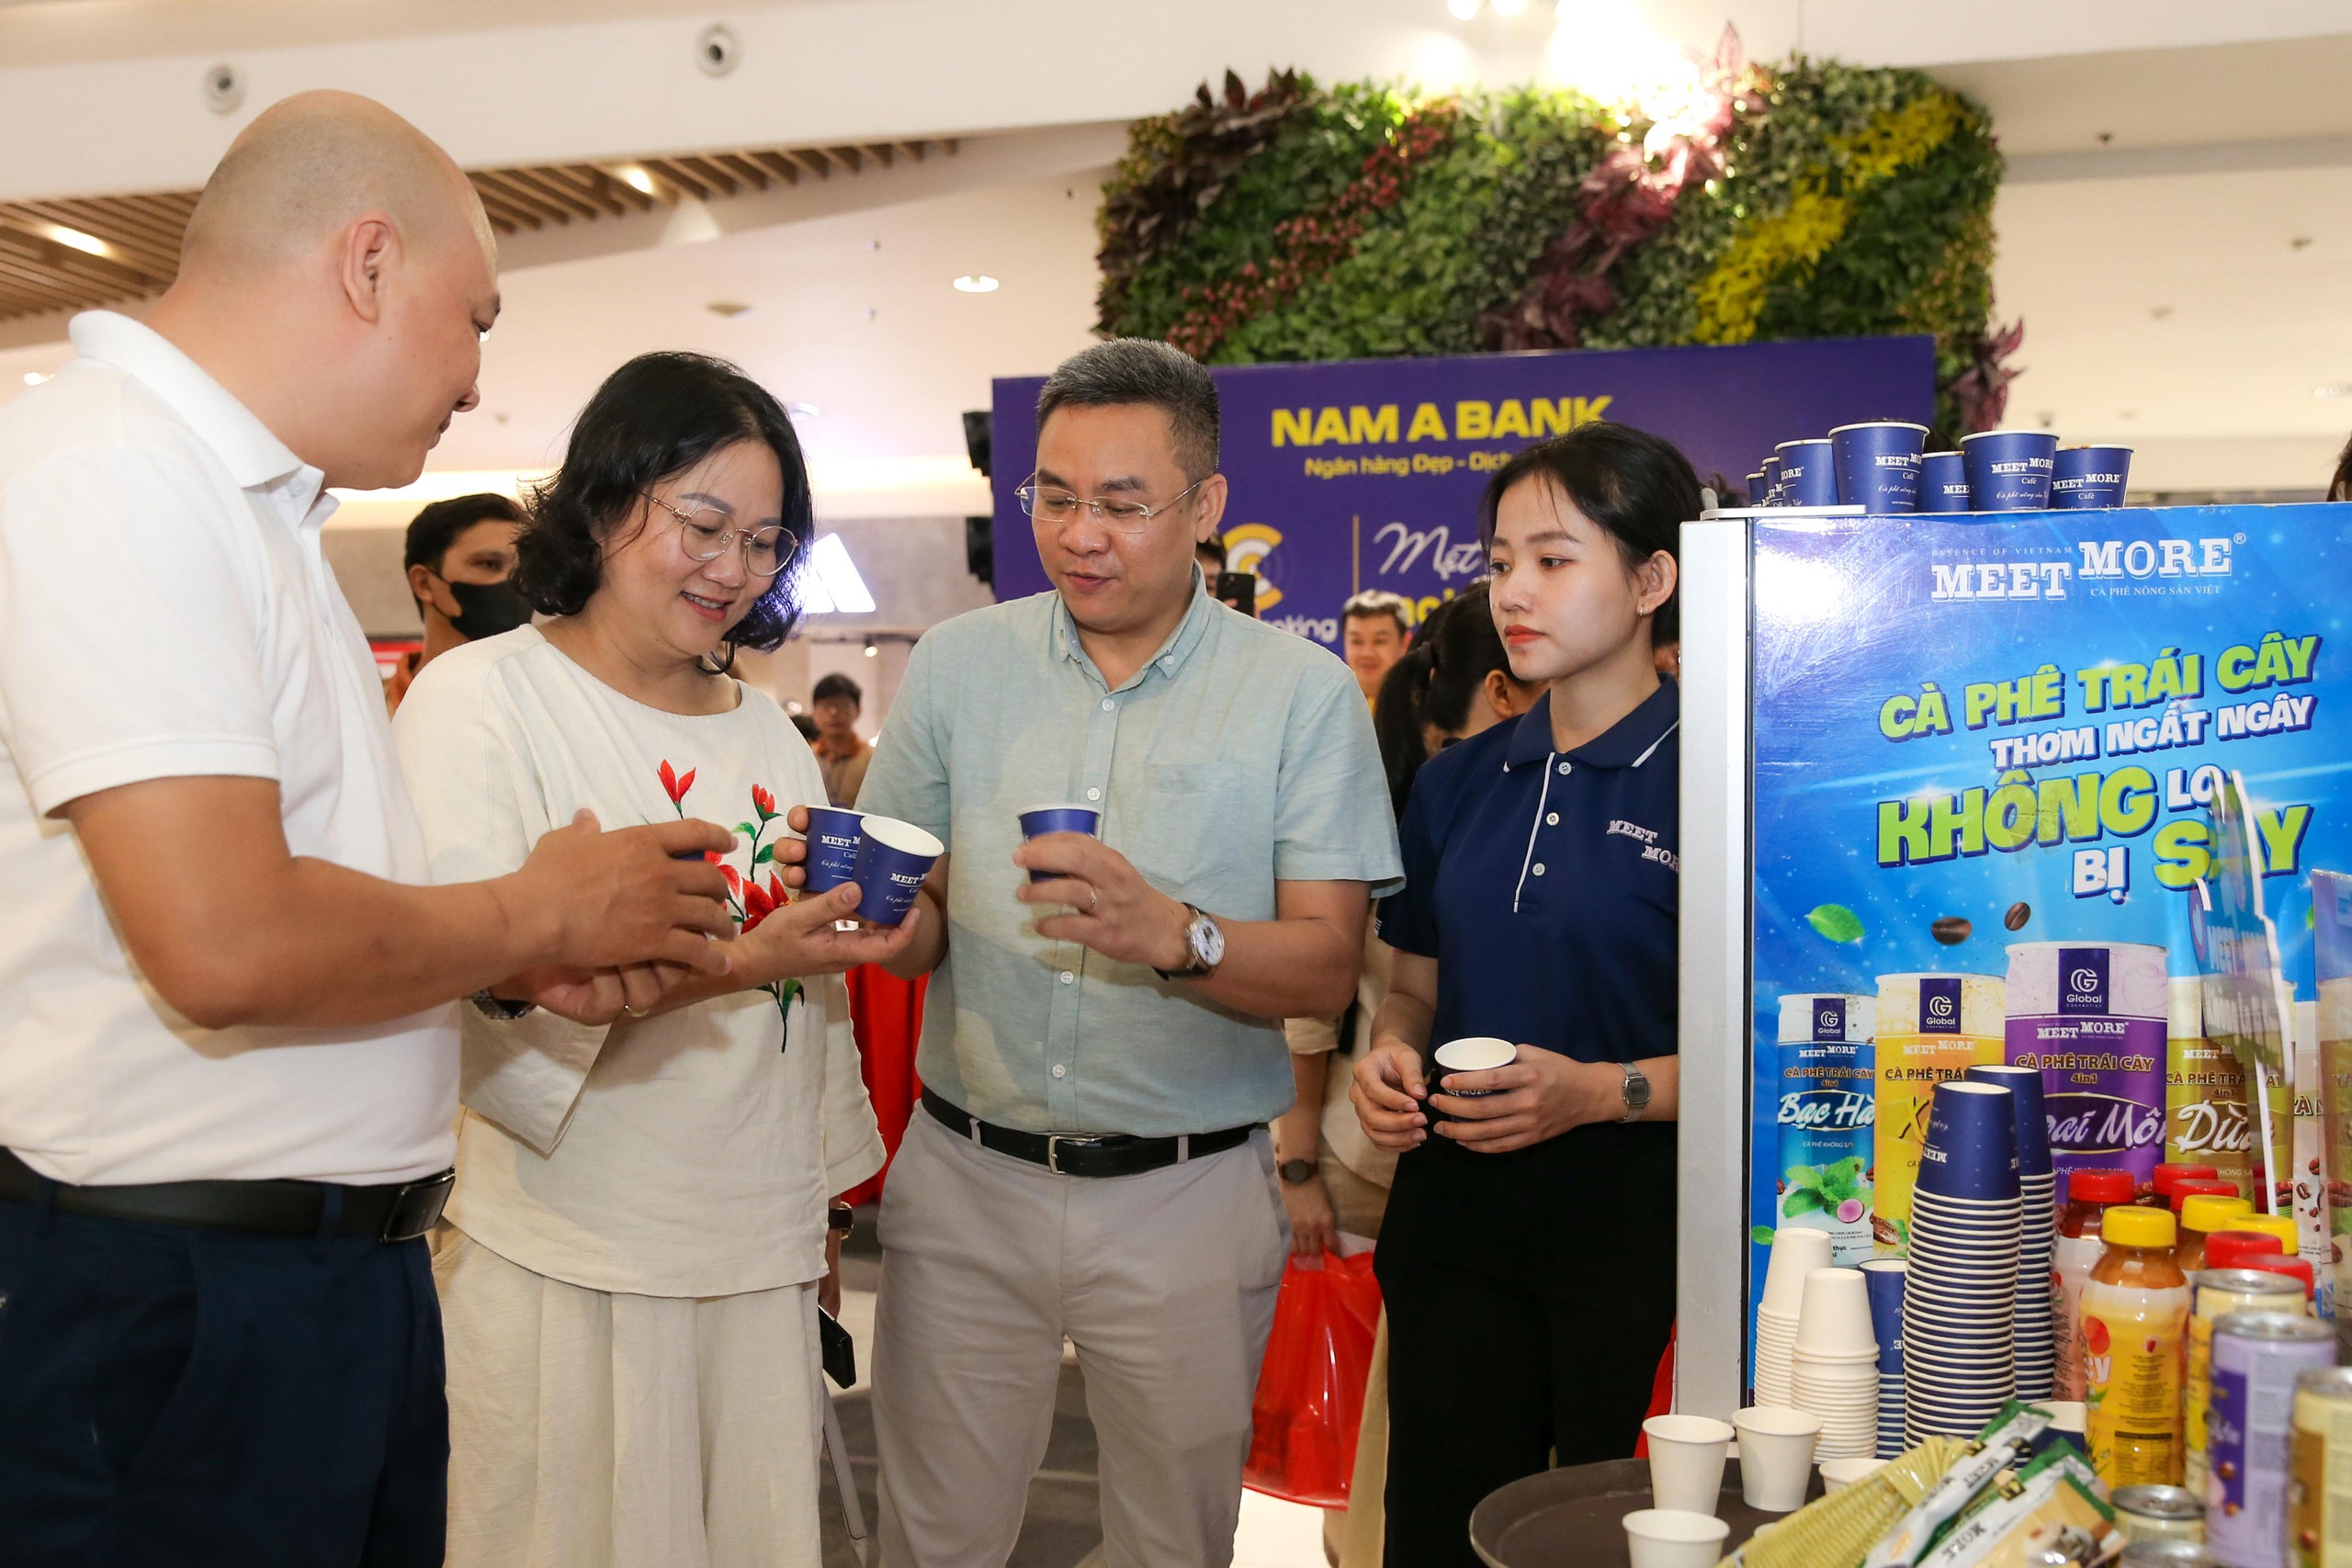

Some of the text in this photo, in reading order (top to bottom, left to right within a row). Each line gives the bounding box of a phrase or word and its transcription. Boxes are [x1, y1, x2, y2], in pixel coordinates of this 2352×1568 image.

[1272, 395, 1612, 447] NAM A BANK
[1360, 454, 1410, 478] hàng
[1875, 456, 1909, 467] MEET
[1991, 462, 2028, 474] MEET
[2052, 473, 2120, 490] MEET MORE
[1943, 485, 1970, 494] MEE
[1993, 547, 2007, 556] OF
[2015, 547, 2073, 555] VIETNAM
[1930, 538, 2233, 603] MEET MORE
[2109, 585, 2131, 596] PHÊ
[2133, 585, 2165, 595] NÔNG
[1879, 631, 2322, 742] CÀ PHÊ TRÁI CÂY
[1990, 694, 2316, 771] THƠM NGẤT NGÂY
[1877, 766, 2159, 868] KHÔNG
[1606, 819, 1658, 844] MEET
[820, 835, 852, 847] MEET
[1641, 845, 1679, 874] MOR
[2073, 803, 2314, 904] BỊ SY
[890, 873, 920, 885] MEET
[2066, 994, 2102, 1003] Global
[1926, 1017, 1956, 1025] Global
[2037, 1021, 2125, 1040] MEET MORE
[1826, 1045, 1856, 1055] MORE
[1903, 1040, 1974, 1055] MEET MORE
[2183, 1049, 2220, 1059] MEET
[2015, 1052, 2154, 1072] CÀ PHÊ TRÁI CÂY
[1784, 1066, 1875, 1078] CÀ PHÊ TRÁI CÂY
[1884, 1066, 1904, 1081] CÀ
[1906, 1066, 1933, 1080] PHÊ
[2070, 1073, 2098, 1084] 4in1
[2166, 1070, 2186, 1085] CÀ
[2188, 1071, 2216, 1085] PHÊ
[2219, 1072, 2245, 1086] TRÁ
[2212, 1089, 2236, 1098] 4in1
[1778, 1092, 1831, 1130] Bạc
[1835, 1093, 1875, 1127] Hà
[2243, 1168, 2254, 1177] SA
